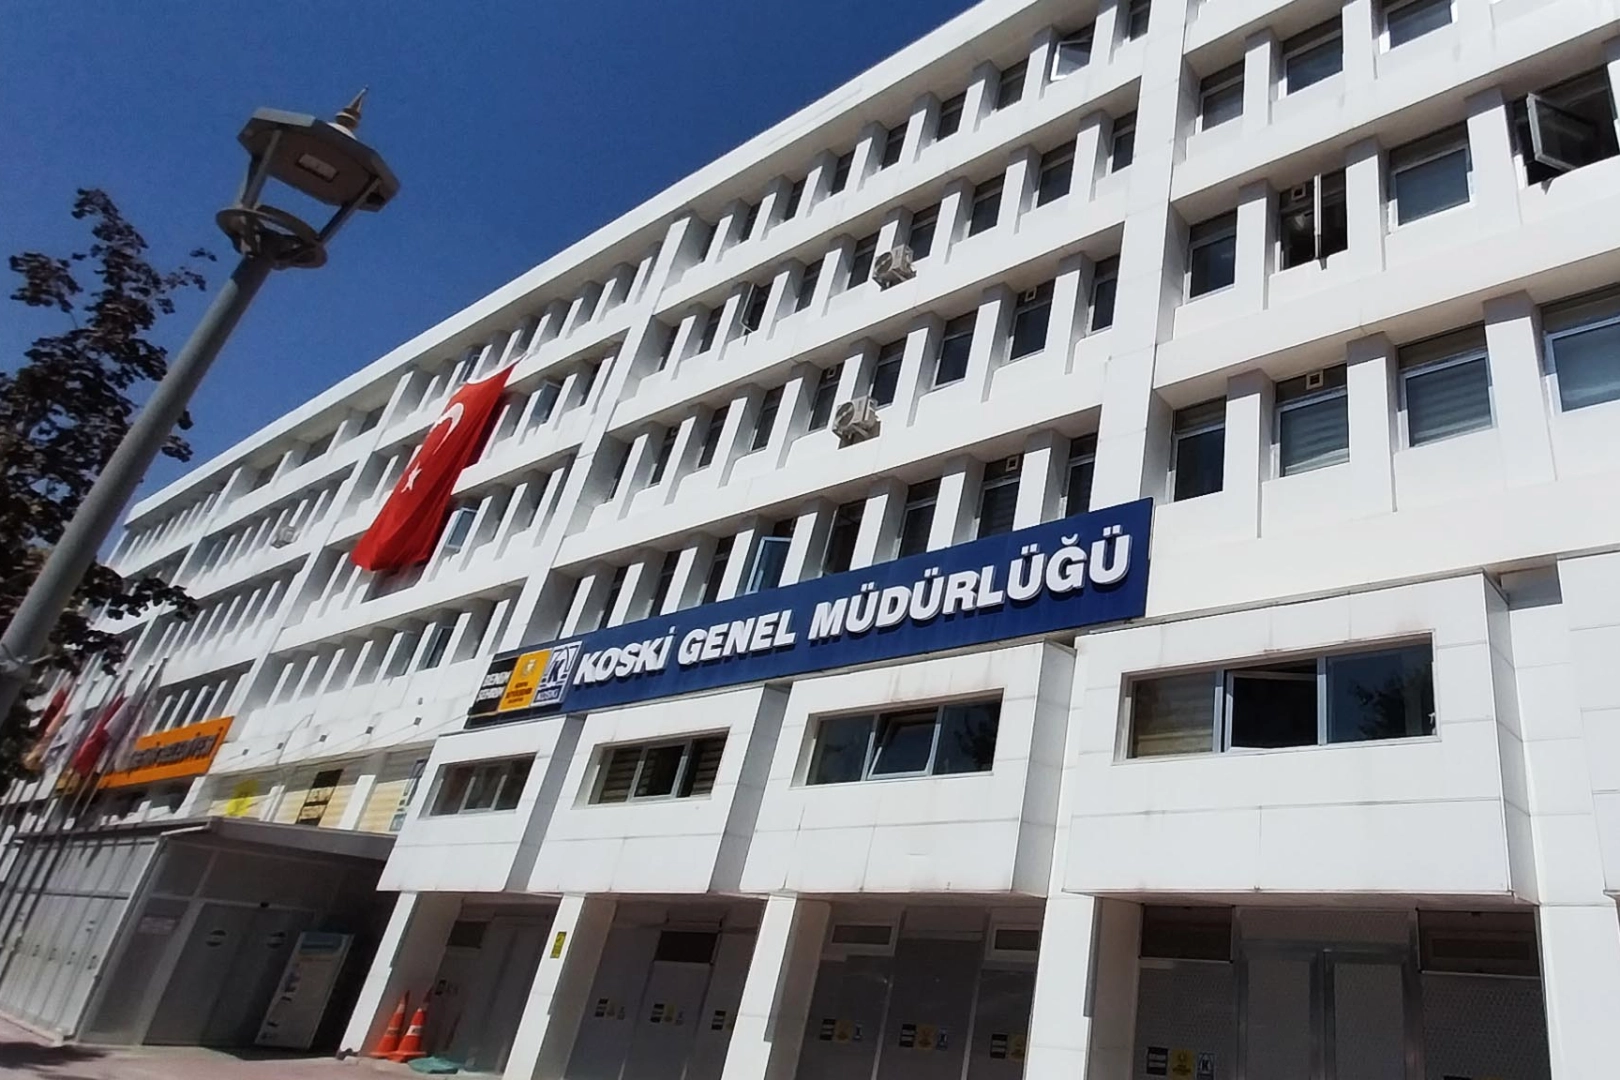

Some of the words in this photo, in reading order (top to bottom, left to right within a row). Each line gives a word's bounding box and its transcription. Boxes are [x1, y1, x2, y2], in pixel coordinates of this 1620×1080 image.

[573, 626, 676, 685] KOSKİ
[678, 609, 797, 665] GENEL
[807, 524, 1133, 640] MÜDÜRLÜĞÜ
